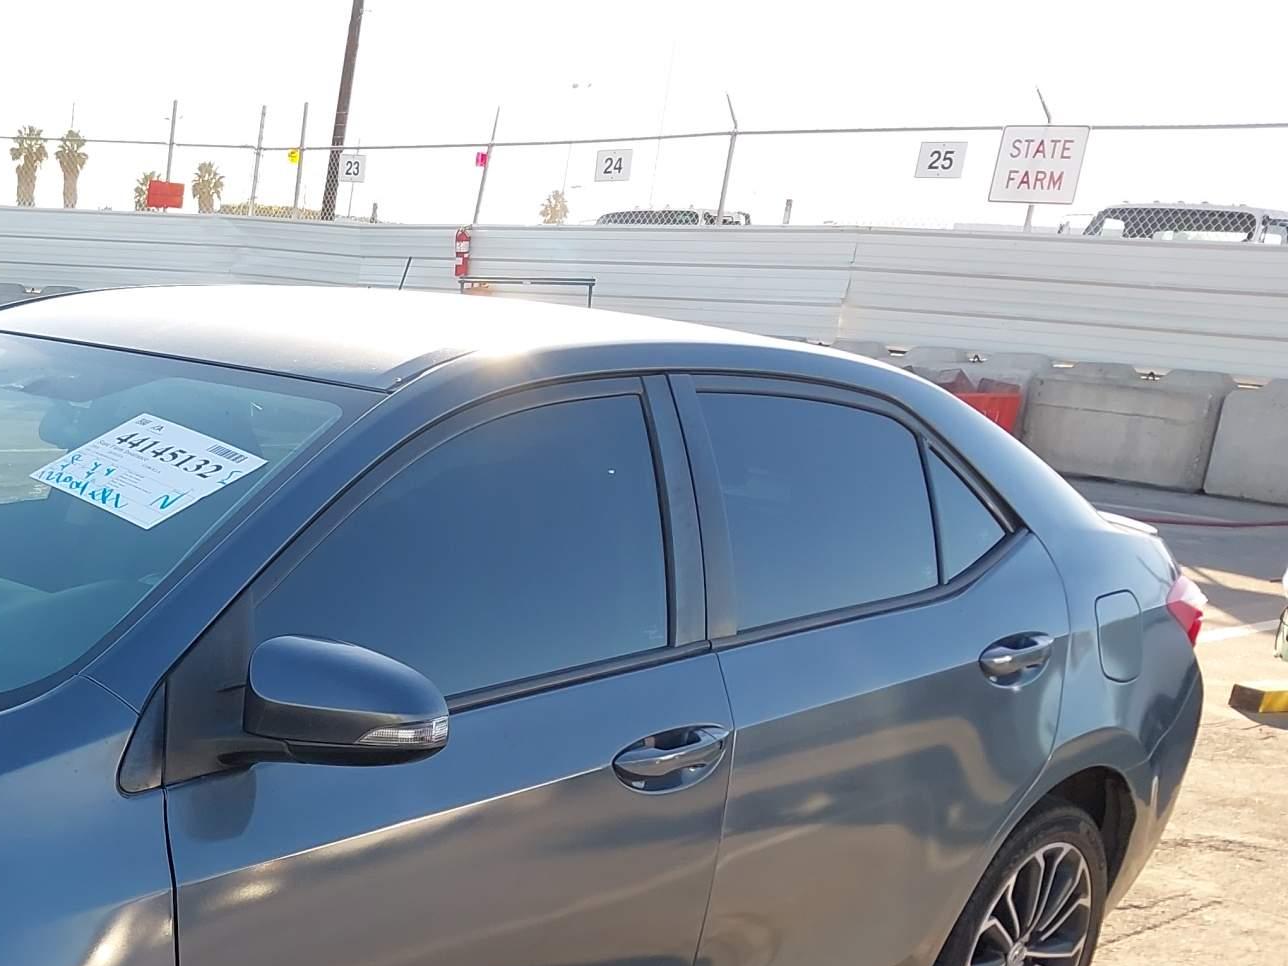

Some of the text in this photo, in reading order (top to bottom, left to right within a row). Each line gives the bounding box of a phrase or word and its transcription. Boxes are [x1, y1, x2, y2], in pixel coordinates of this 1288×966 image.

[1010, 139, 1074, 159] STATE
[345, 160, 360, 176] 23
[603, 157, 623, 174] 24
[927, 150, 956, 170] 25
[1006, 170, 1064, 190] FARM
[116, 432, 223, 478] 44145132
